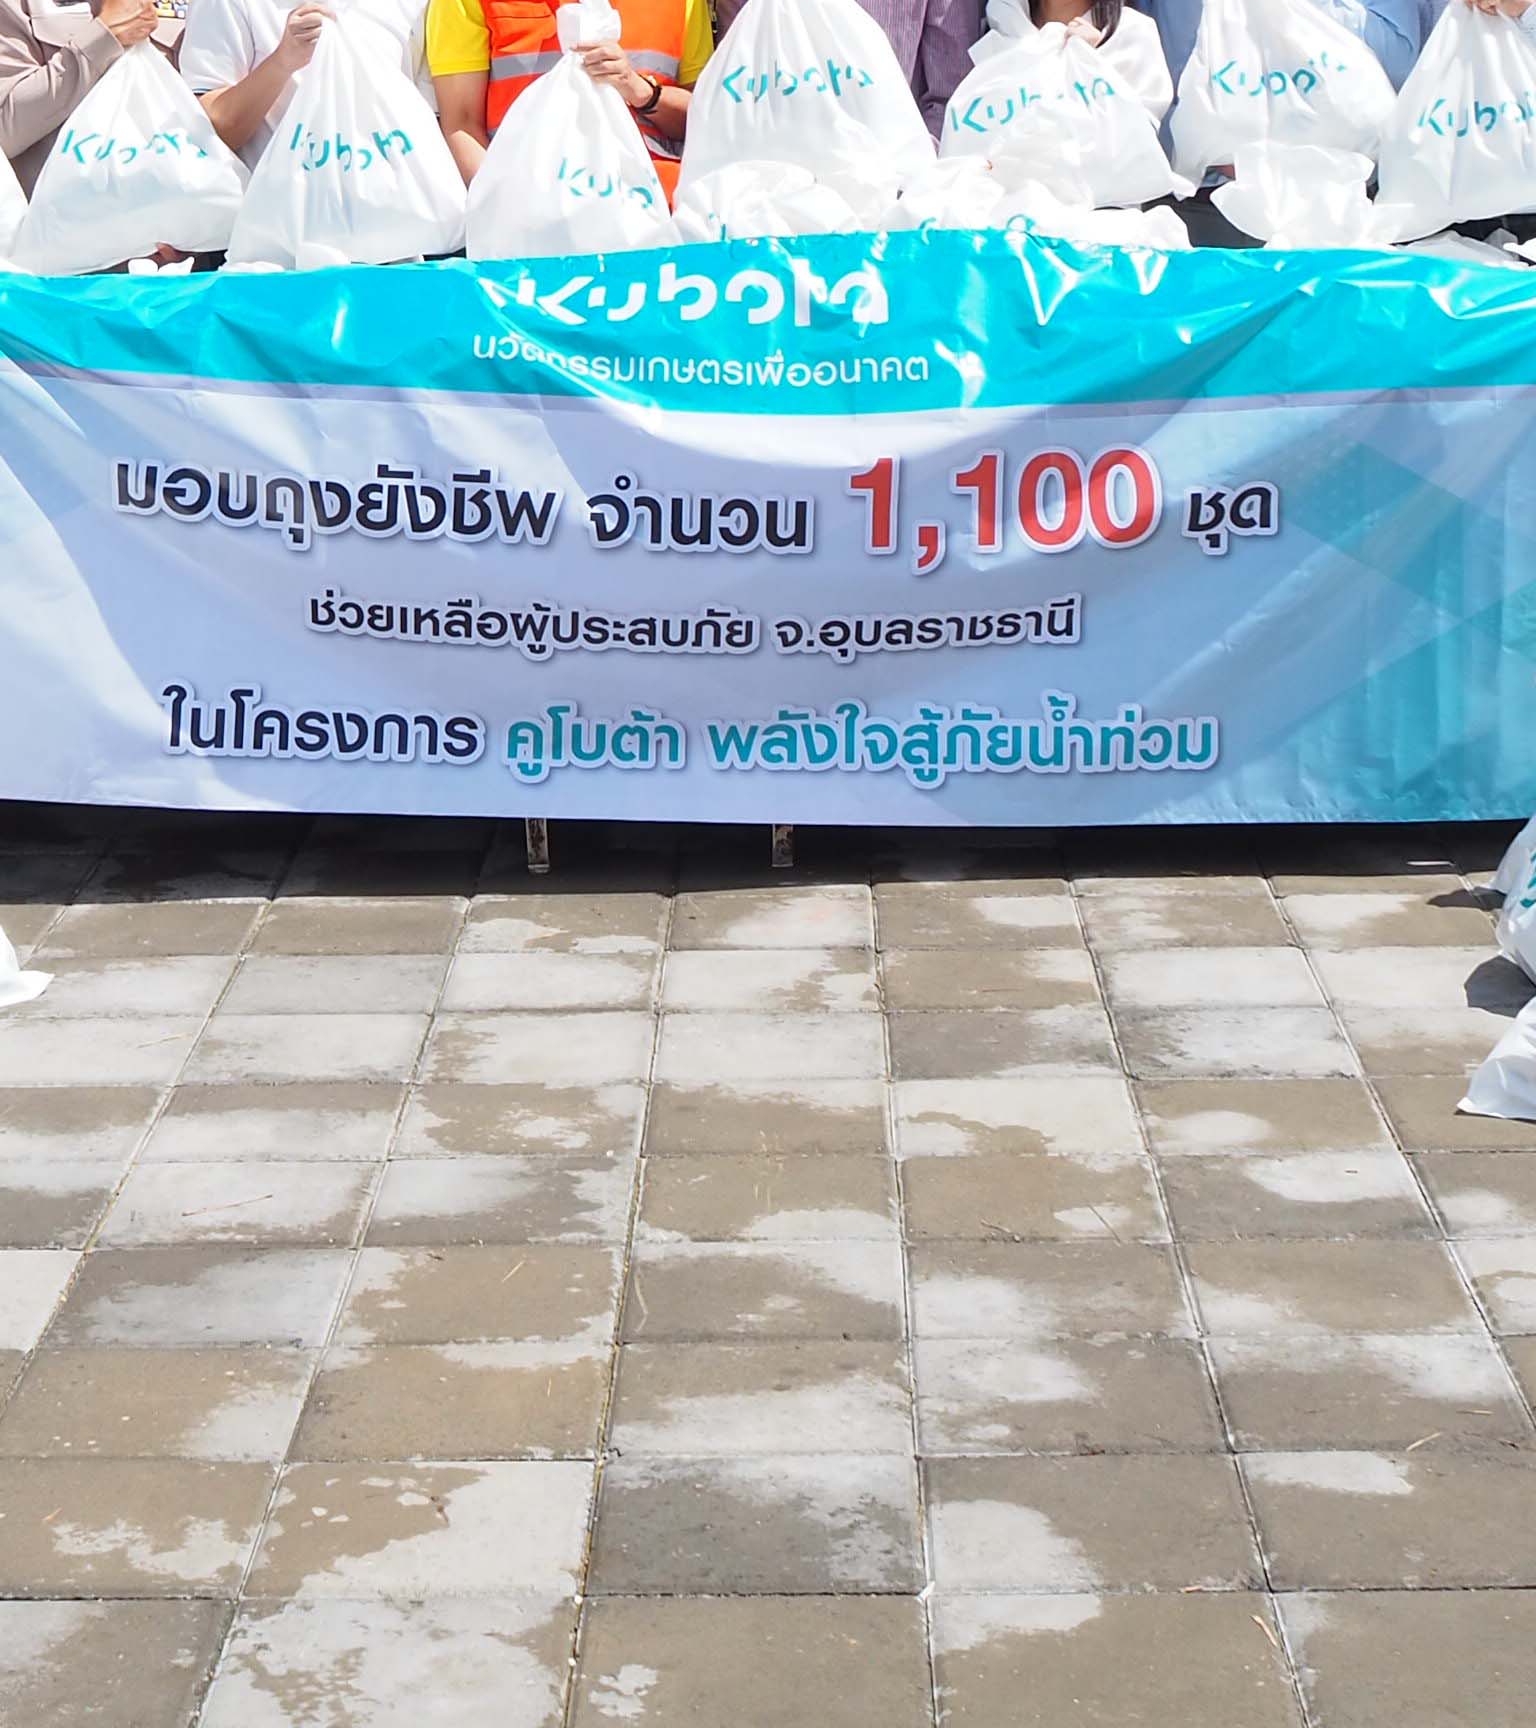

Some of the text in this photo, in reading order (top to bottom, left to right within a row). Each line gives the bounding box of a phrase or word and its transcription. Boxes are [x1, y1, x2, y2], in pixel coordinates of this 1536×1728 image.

[950, 78, 1115, 133] Kubta
[117, 451, 1272, 569] มอบถุงยังชีพ จำนวน 1,100 ชุด
[309, 589, 1076, 658] ช่วยเหลือผู้ประสบภัย จ.อุบลราชธานี
[163, 684, 1213, 783] ในโครงการ คูโบต้า พลังใจสู้ภัยน้ำท่วม
